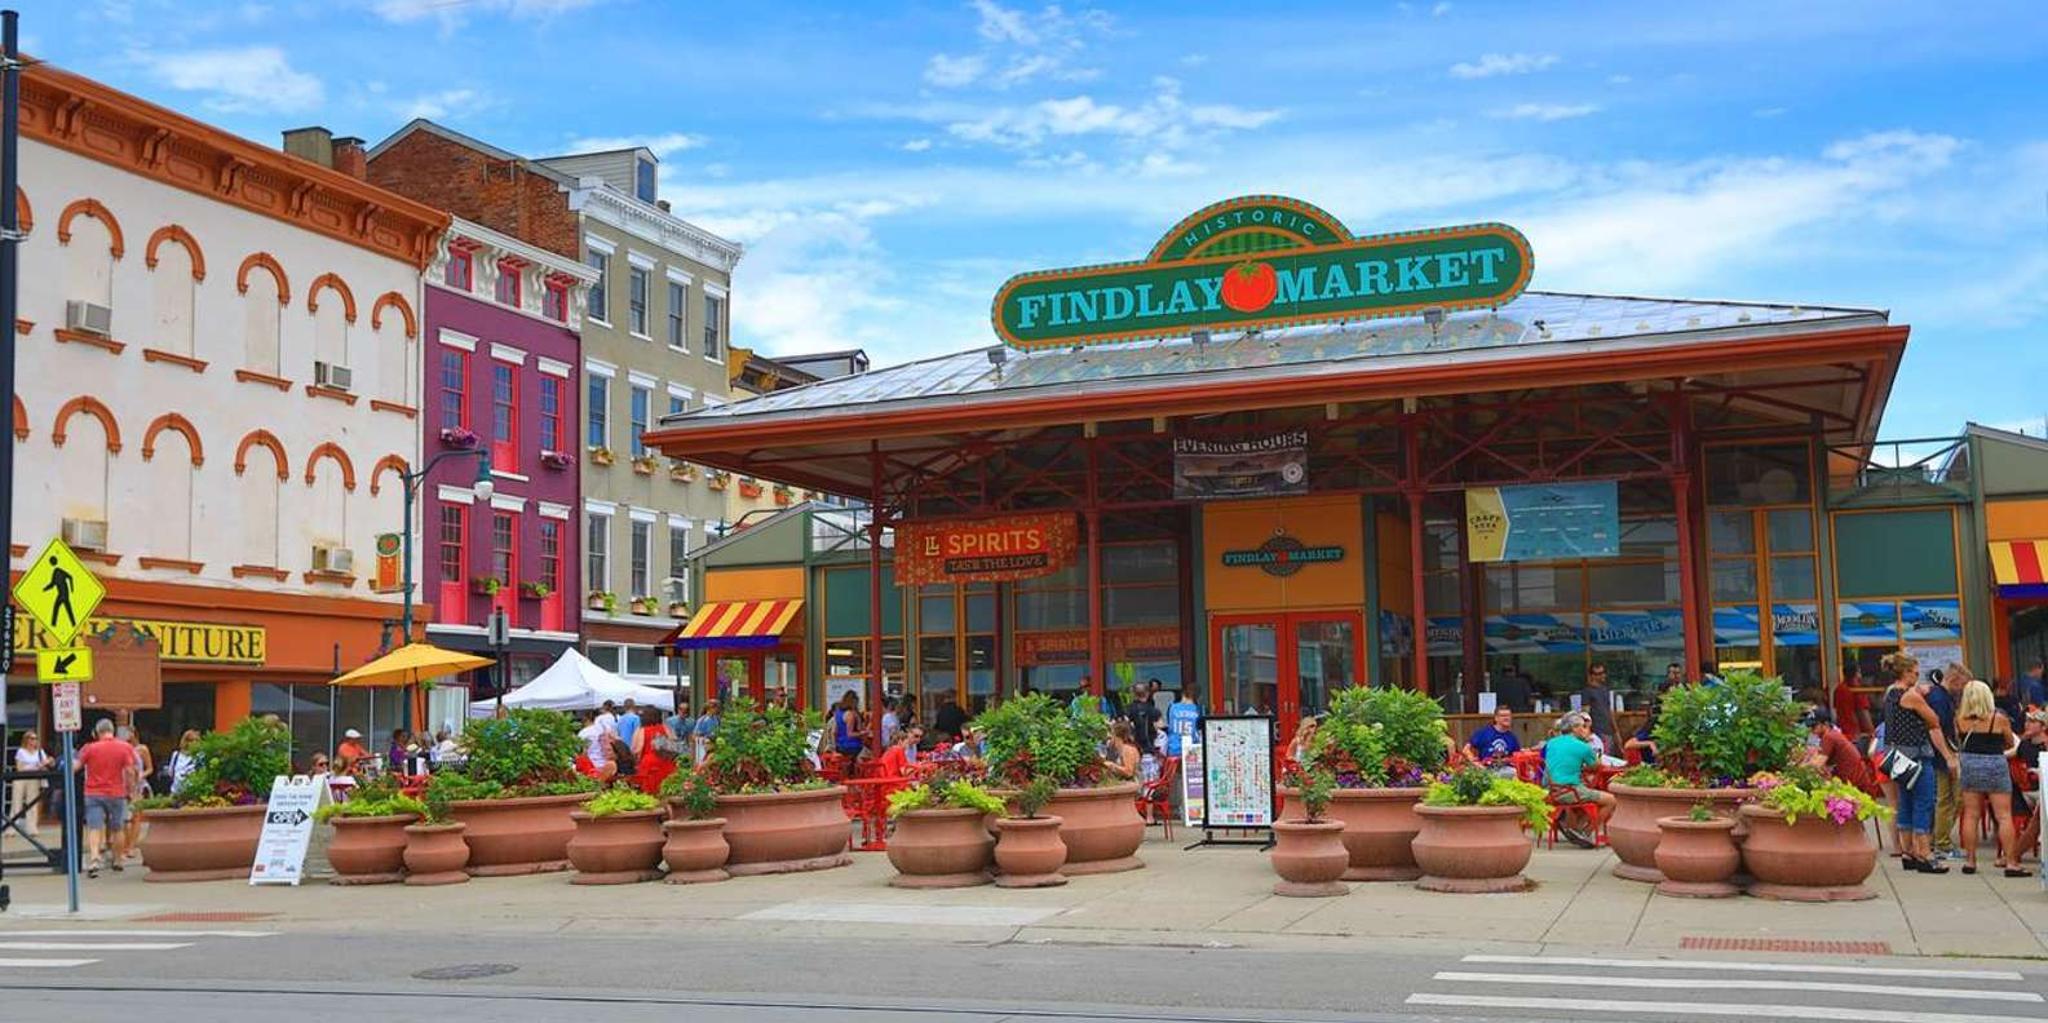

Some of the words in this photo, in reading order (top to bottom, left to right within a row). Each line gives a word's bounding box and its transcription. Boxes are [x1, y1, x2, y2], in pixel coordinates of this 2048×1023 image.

[1185, 209, 1316, 248] HISTORIC
[1017, 276, 1224, 330] FINDLAY
[1274, 247, 1506, 304] MARKET
[949, 529, 1041, 554] SPIRITS
[1224, 550, 1276, 565] FINDLAY
[1288, 547, 1343, 562] MARKET
[273, 811, 304, 824] OPEN
